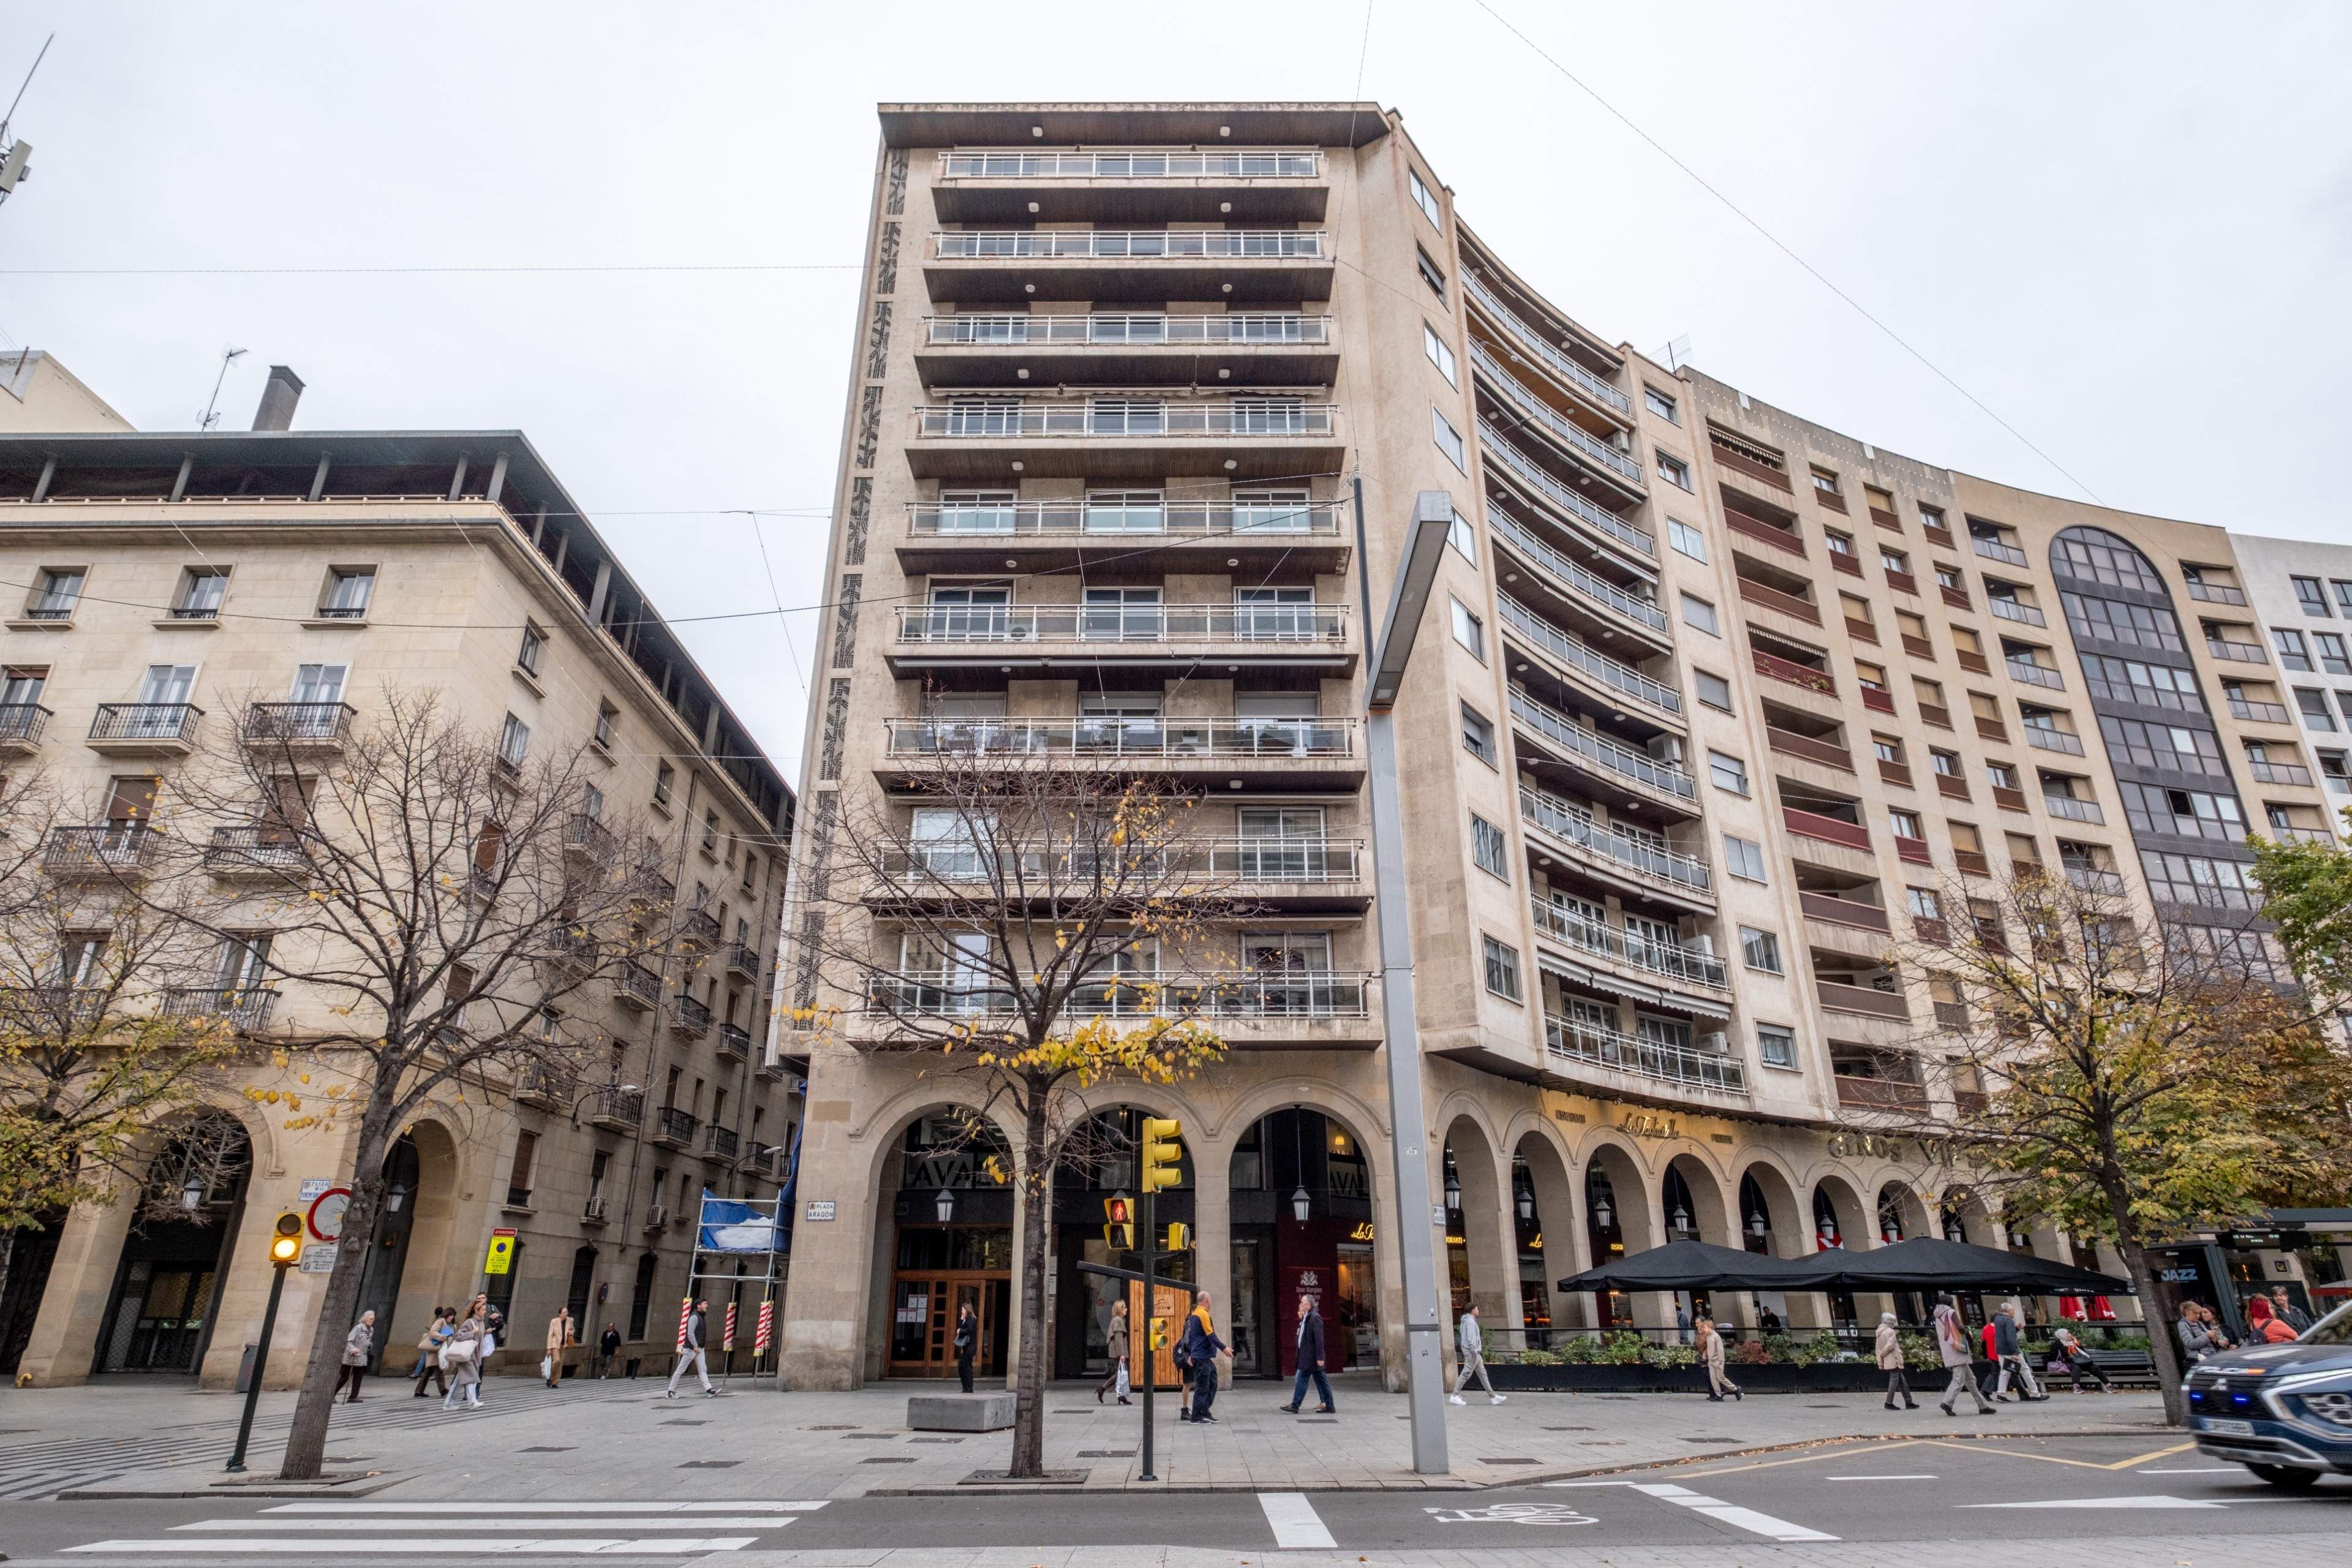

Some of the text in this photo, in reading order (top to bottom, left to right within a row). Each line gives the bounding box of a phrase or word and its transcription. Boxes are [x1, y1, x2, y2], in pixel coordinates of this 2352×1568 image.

[1351, 1223, 1365, 1239] La
[1529, 1233, 1542, 1248] La
[2161, 1268, 2198, 1281] JAZZ
